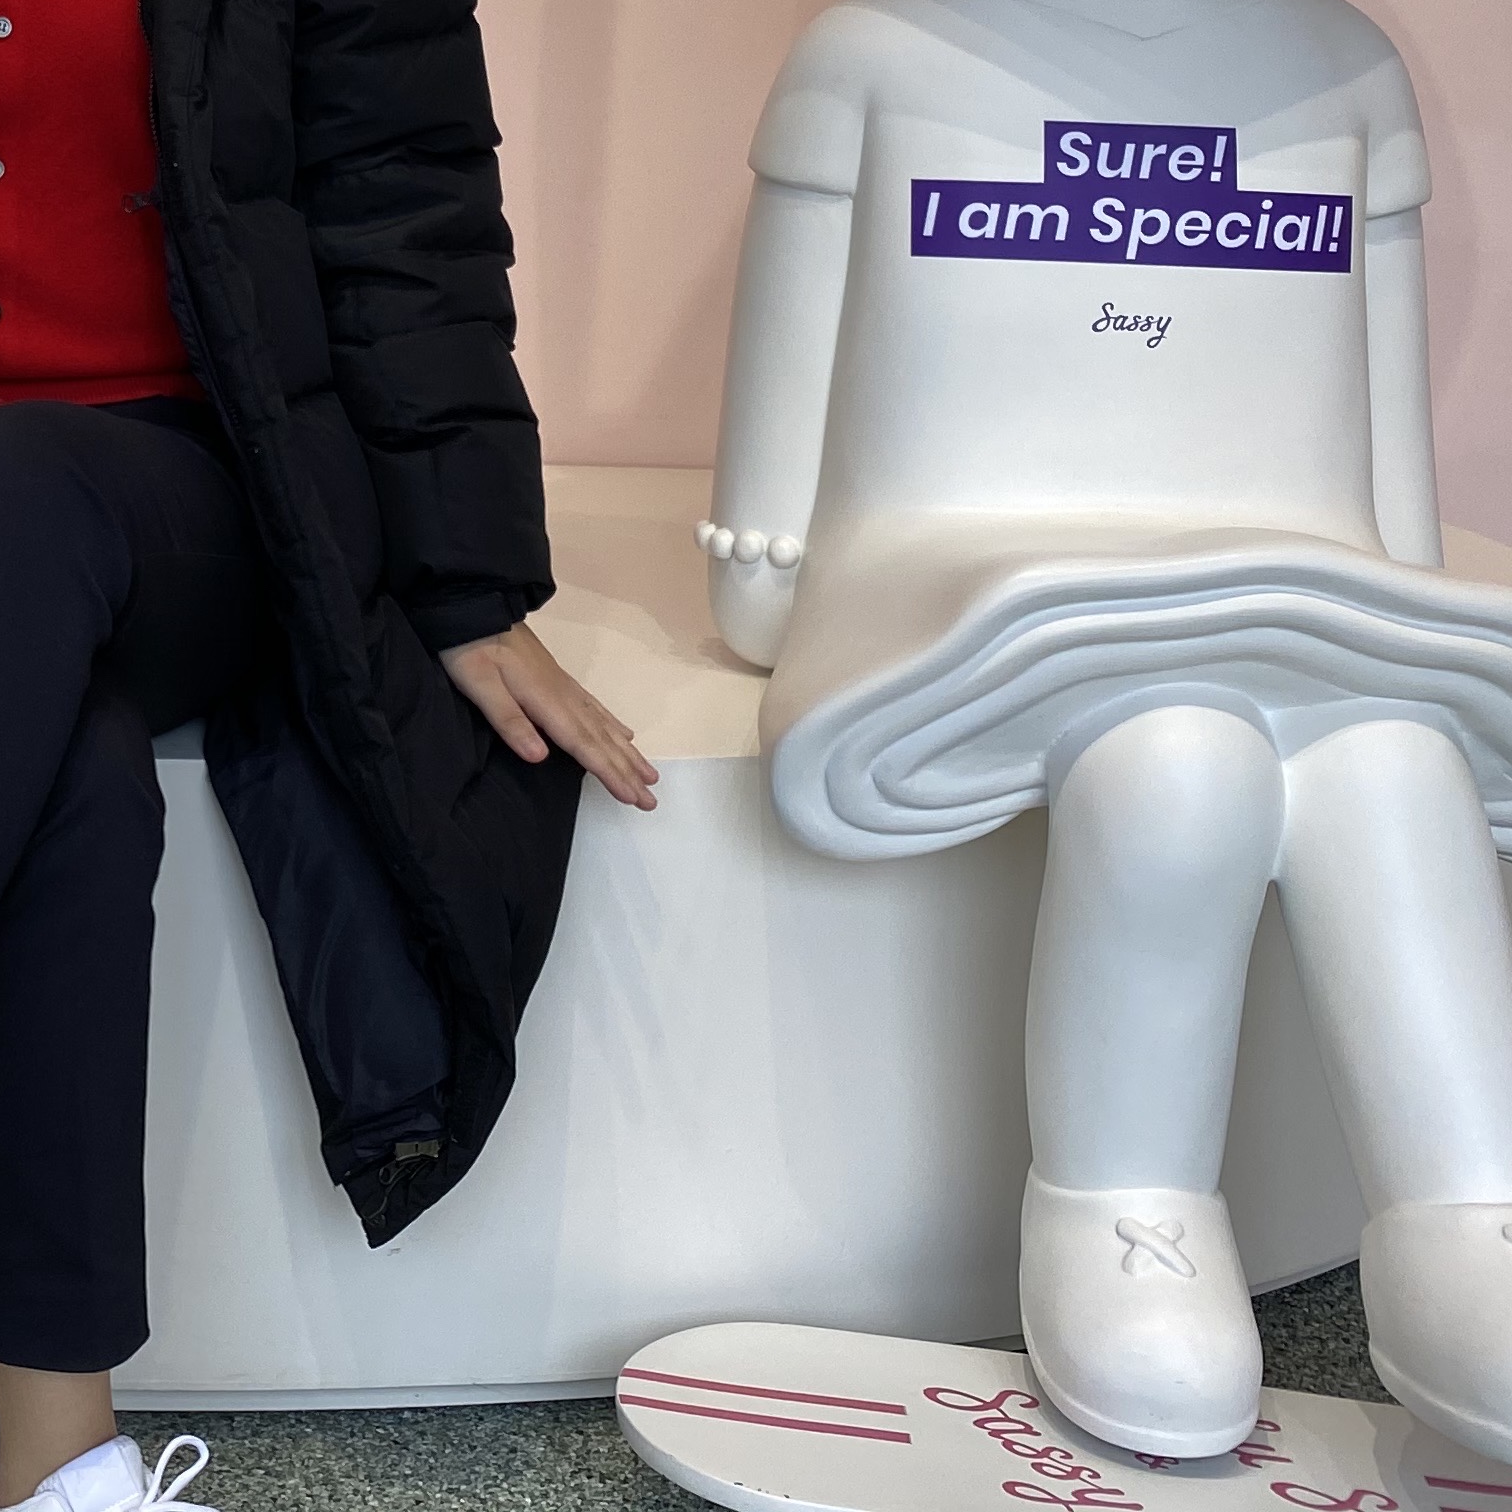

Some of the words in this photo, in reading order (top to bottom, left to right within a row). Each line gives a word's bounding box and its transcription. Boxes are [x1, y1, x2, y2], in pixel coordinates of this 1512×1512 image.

[1056, 131, 1227, 182] Sure!
[923, 192, 940, 237] I
[958, 203, 1070, 241] am
[1089, 197, 1344, 260] Special!
[1091, 303, 1172, 349] Sassy
[922, 1387, 1144, 1512] Sassy
